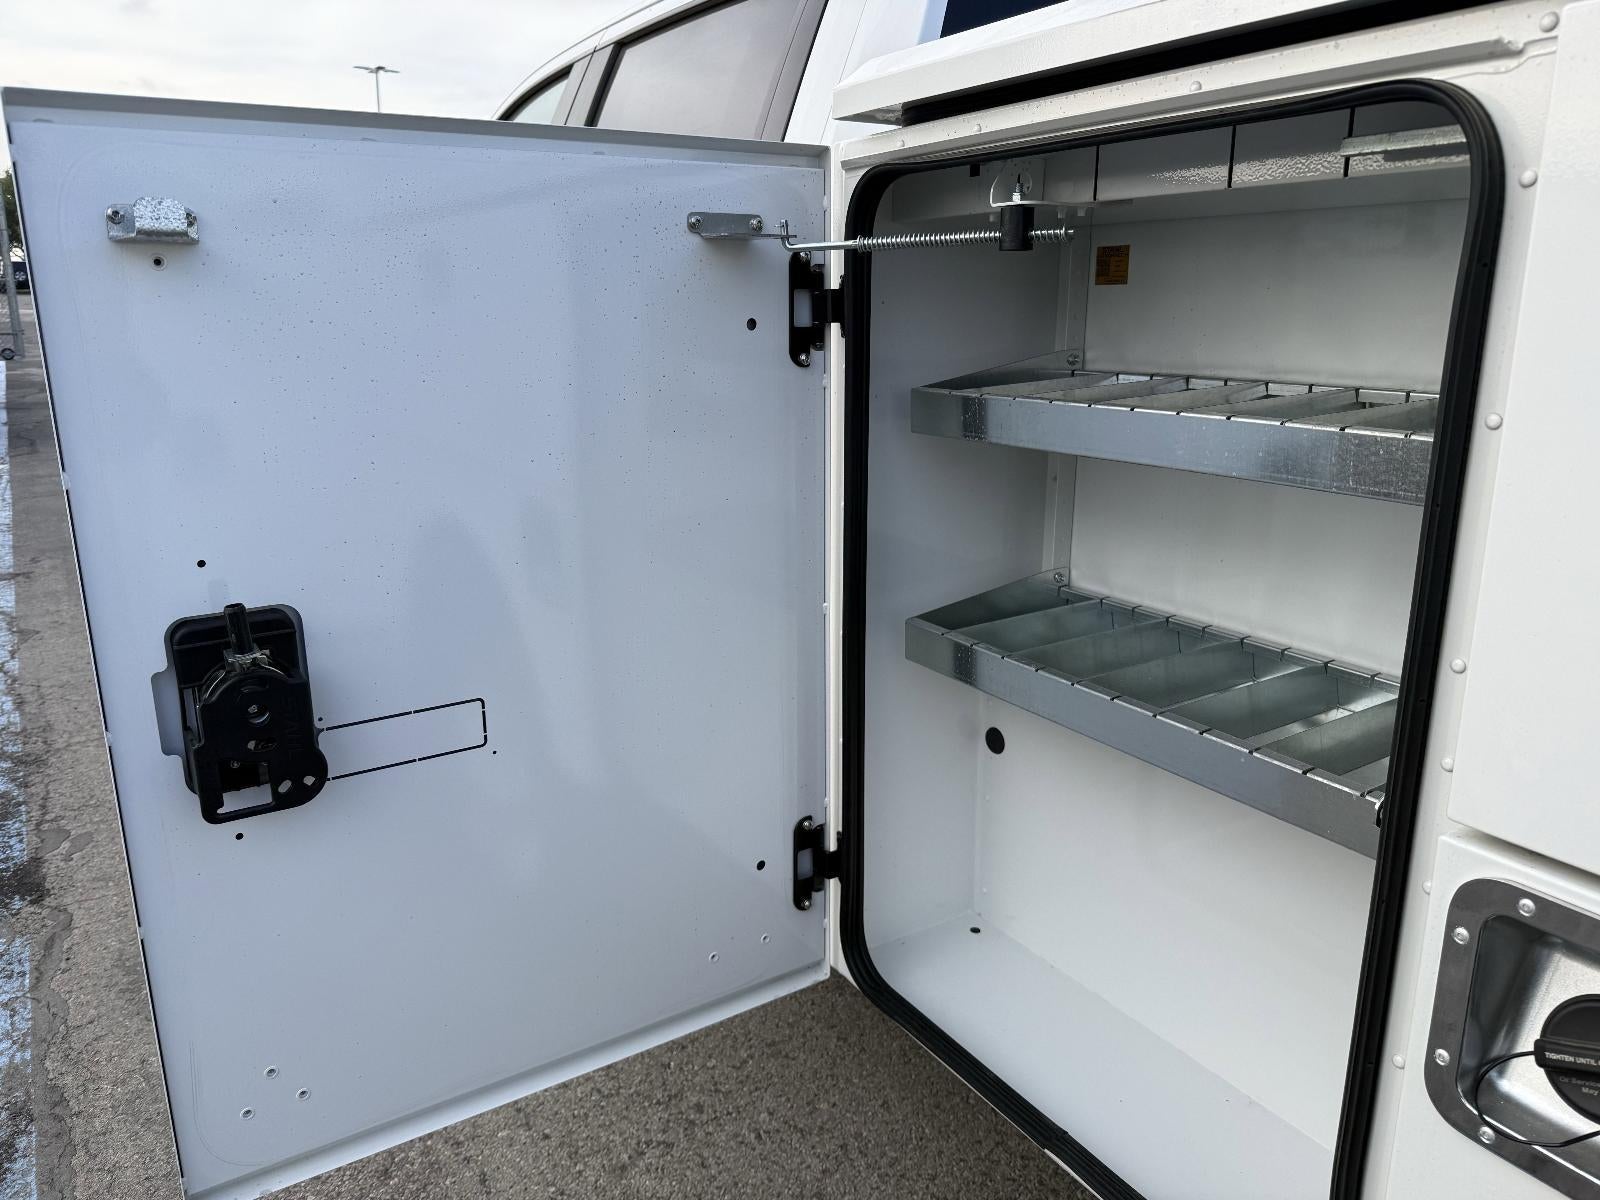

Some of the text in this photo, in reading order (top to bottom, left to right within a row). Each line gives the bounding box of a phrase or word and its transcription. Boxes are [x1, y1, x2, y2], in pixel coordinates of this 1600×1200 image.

[1544, 1051, 1574, 1063] TIGHTEN
[1575, 1056, 1597, 1066] UNTIL
[1581, 1086, 1599, 1096] May
